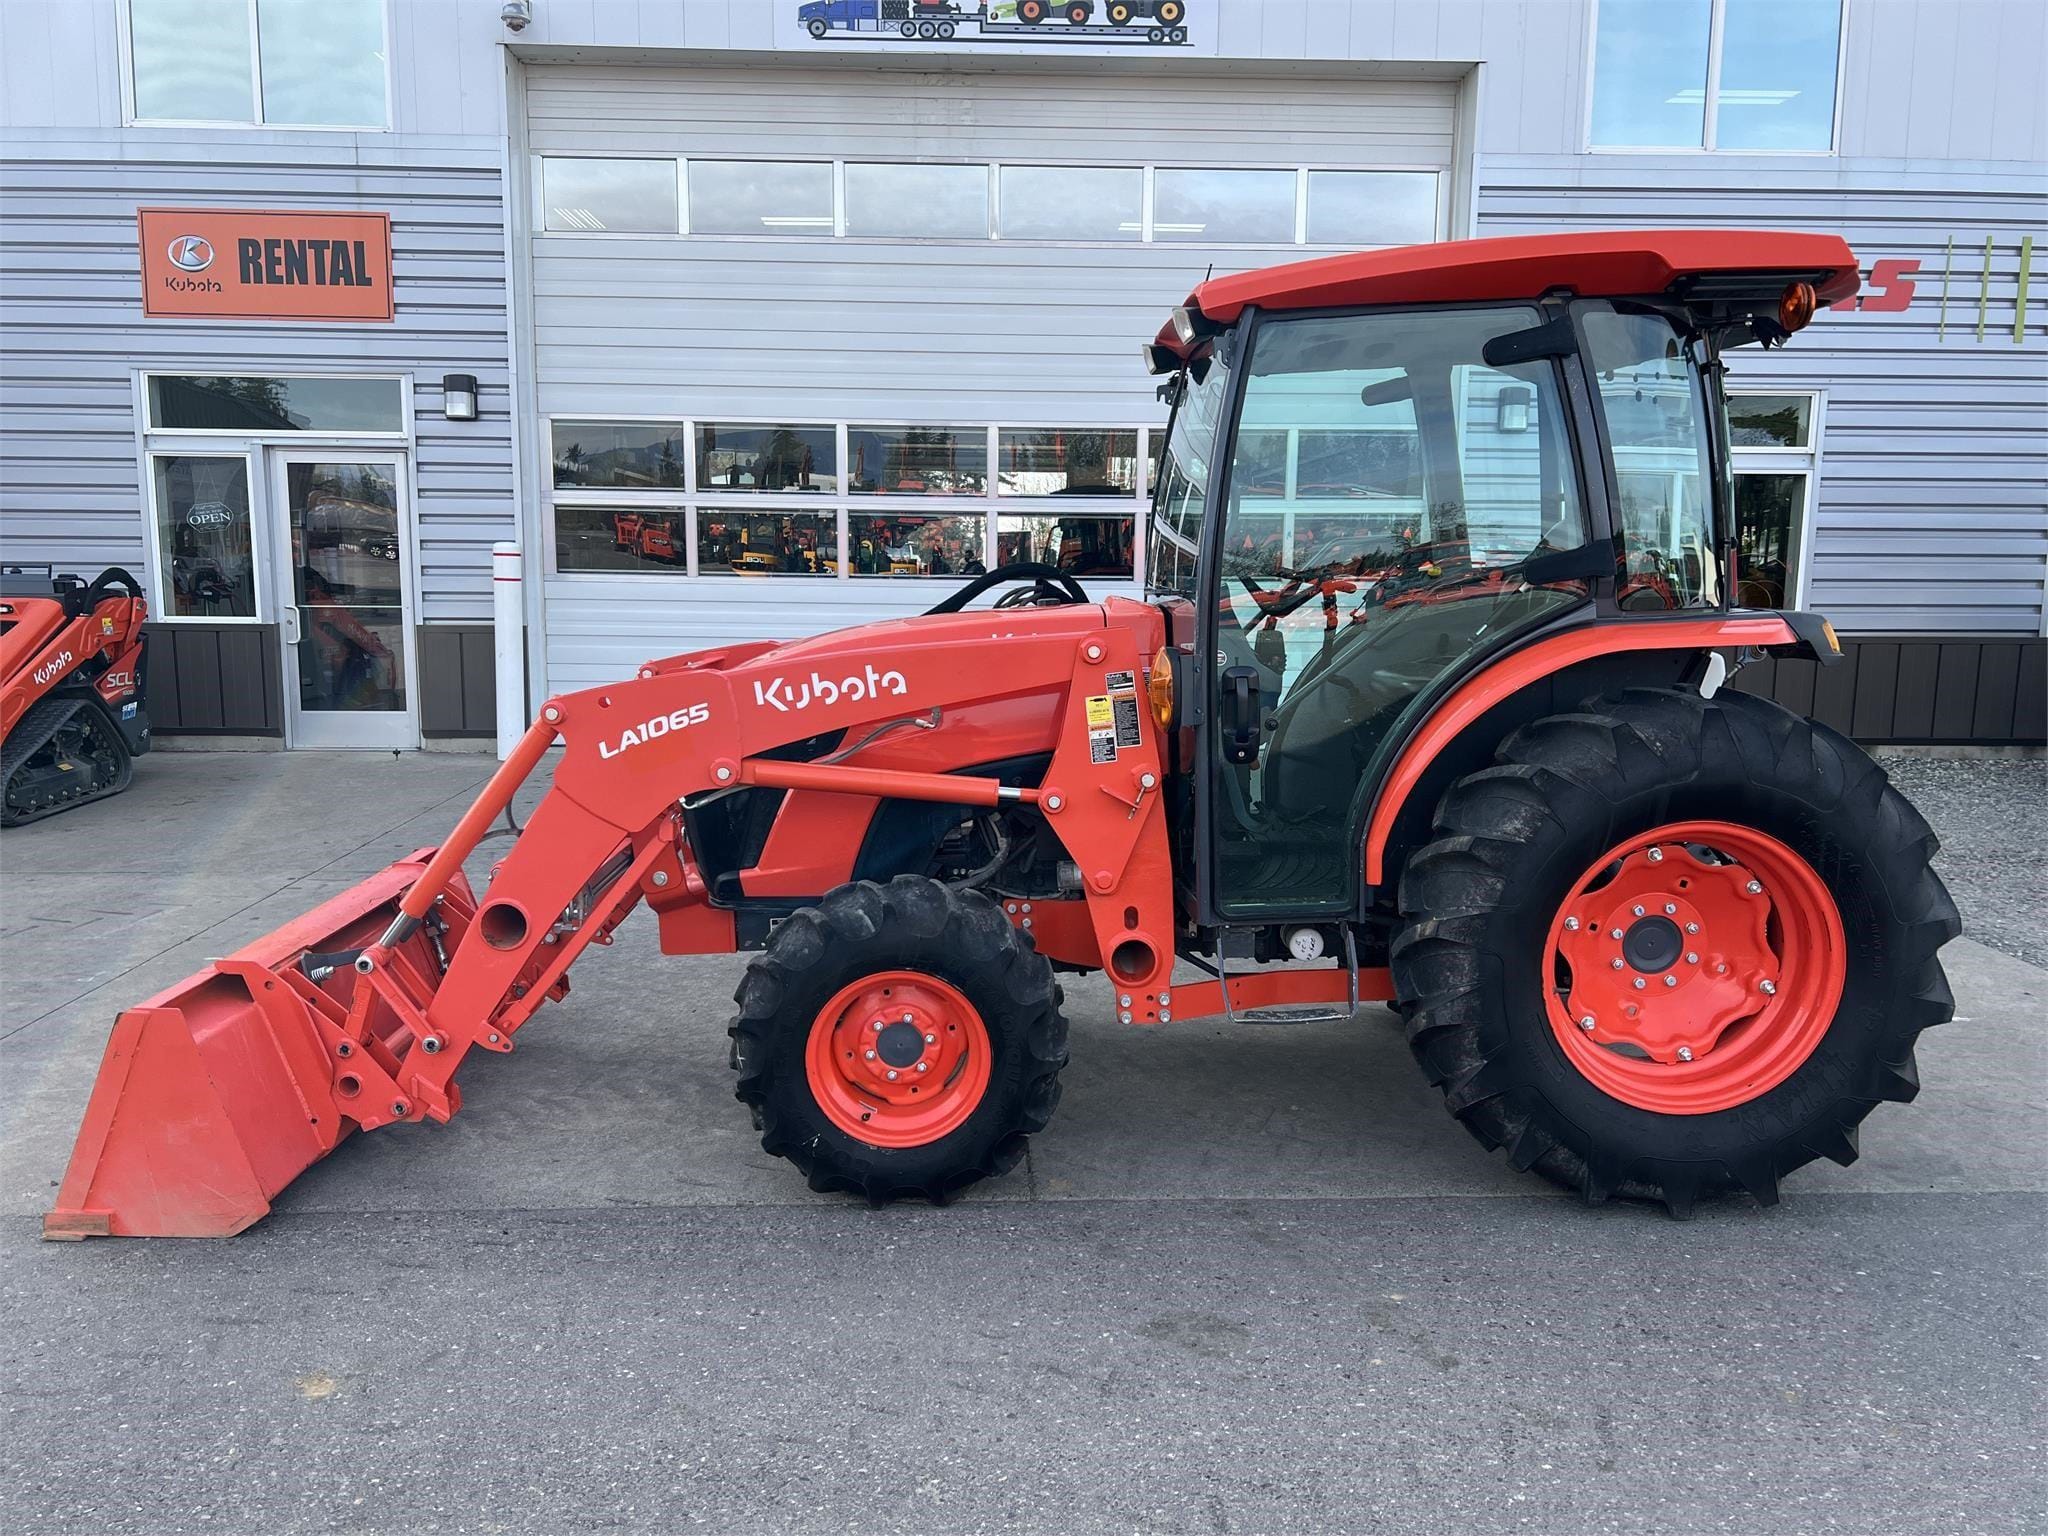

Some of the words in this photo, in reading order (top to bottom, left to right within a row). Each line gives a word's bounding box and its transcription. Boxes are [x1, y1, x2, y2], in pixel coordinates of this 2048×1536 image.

[237, 238, 373, 287] RENTAL
[165, 277, 222, 292] Kubota
[189, 512, 231, 525] OPEN
[33, 651, 72, 684] Kubota
[106, 671, 133, 688] SCL
[753, 665, 908, 712] Kubota
[598, 702, 711, 759] LA1065
